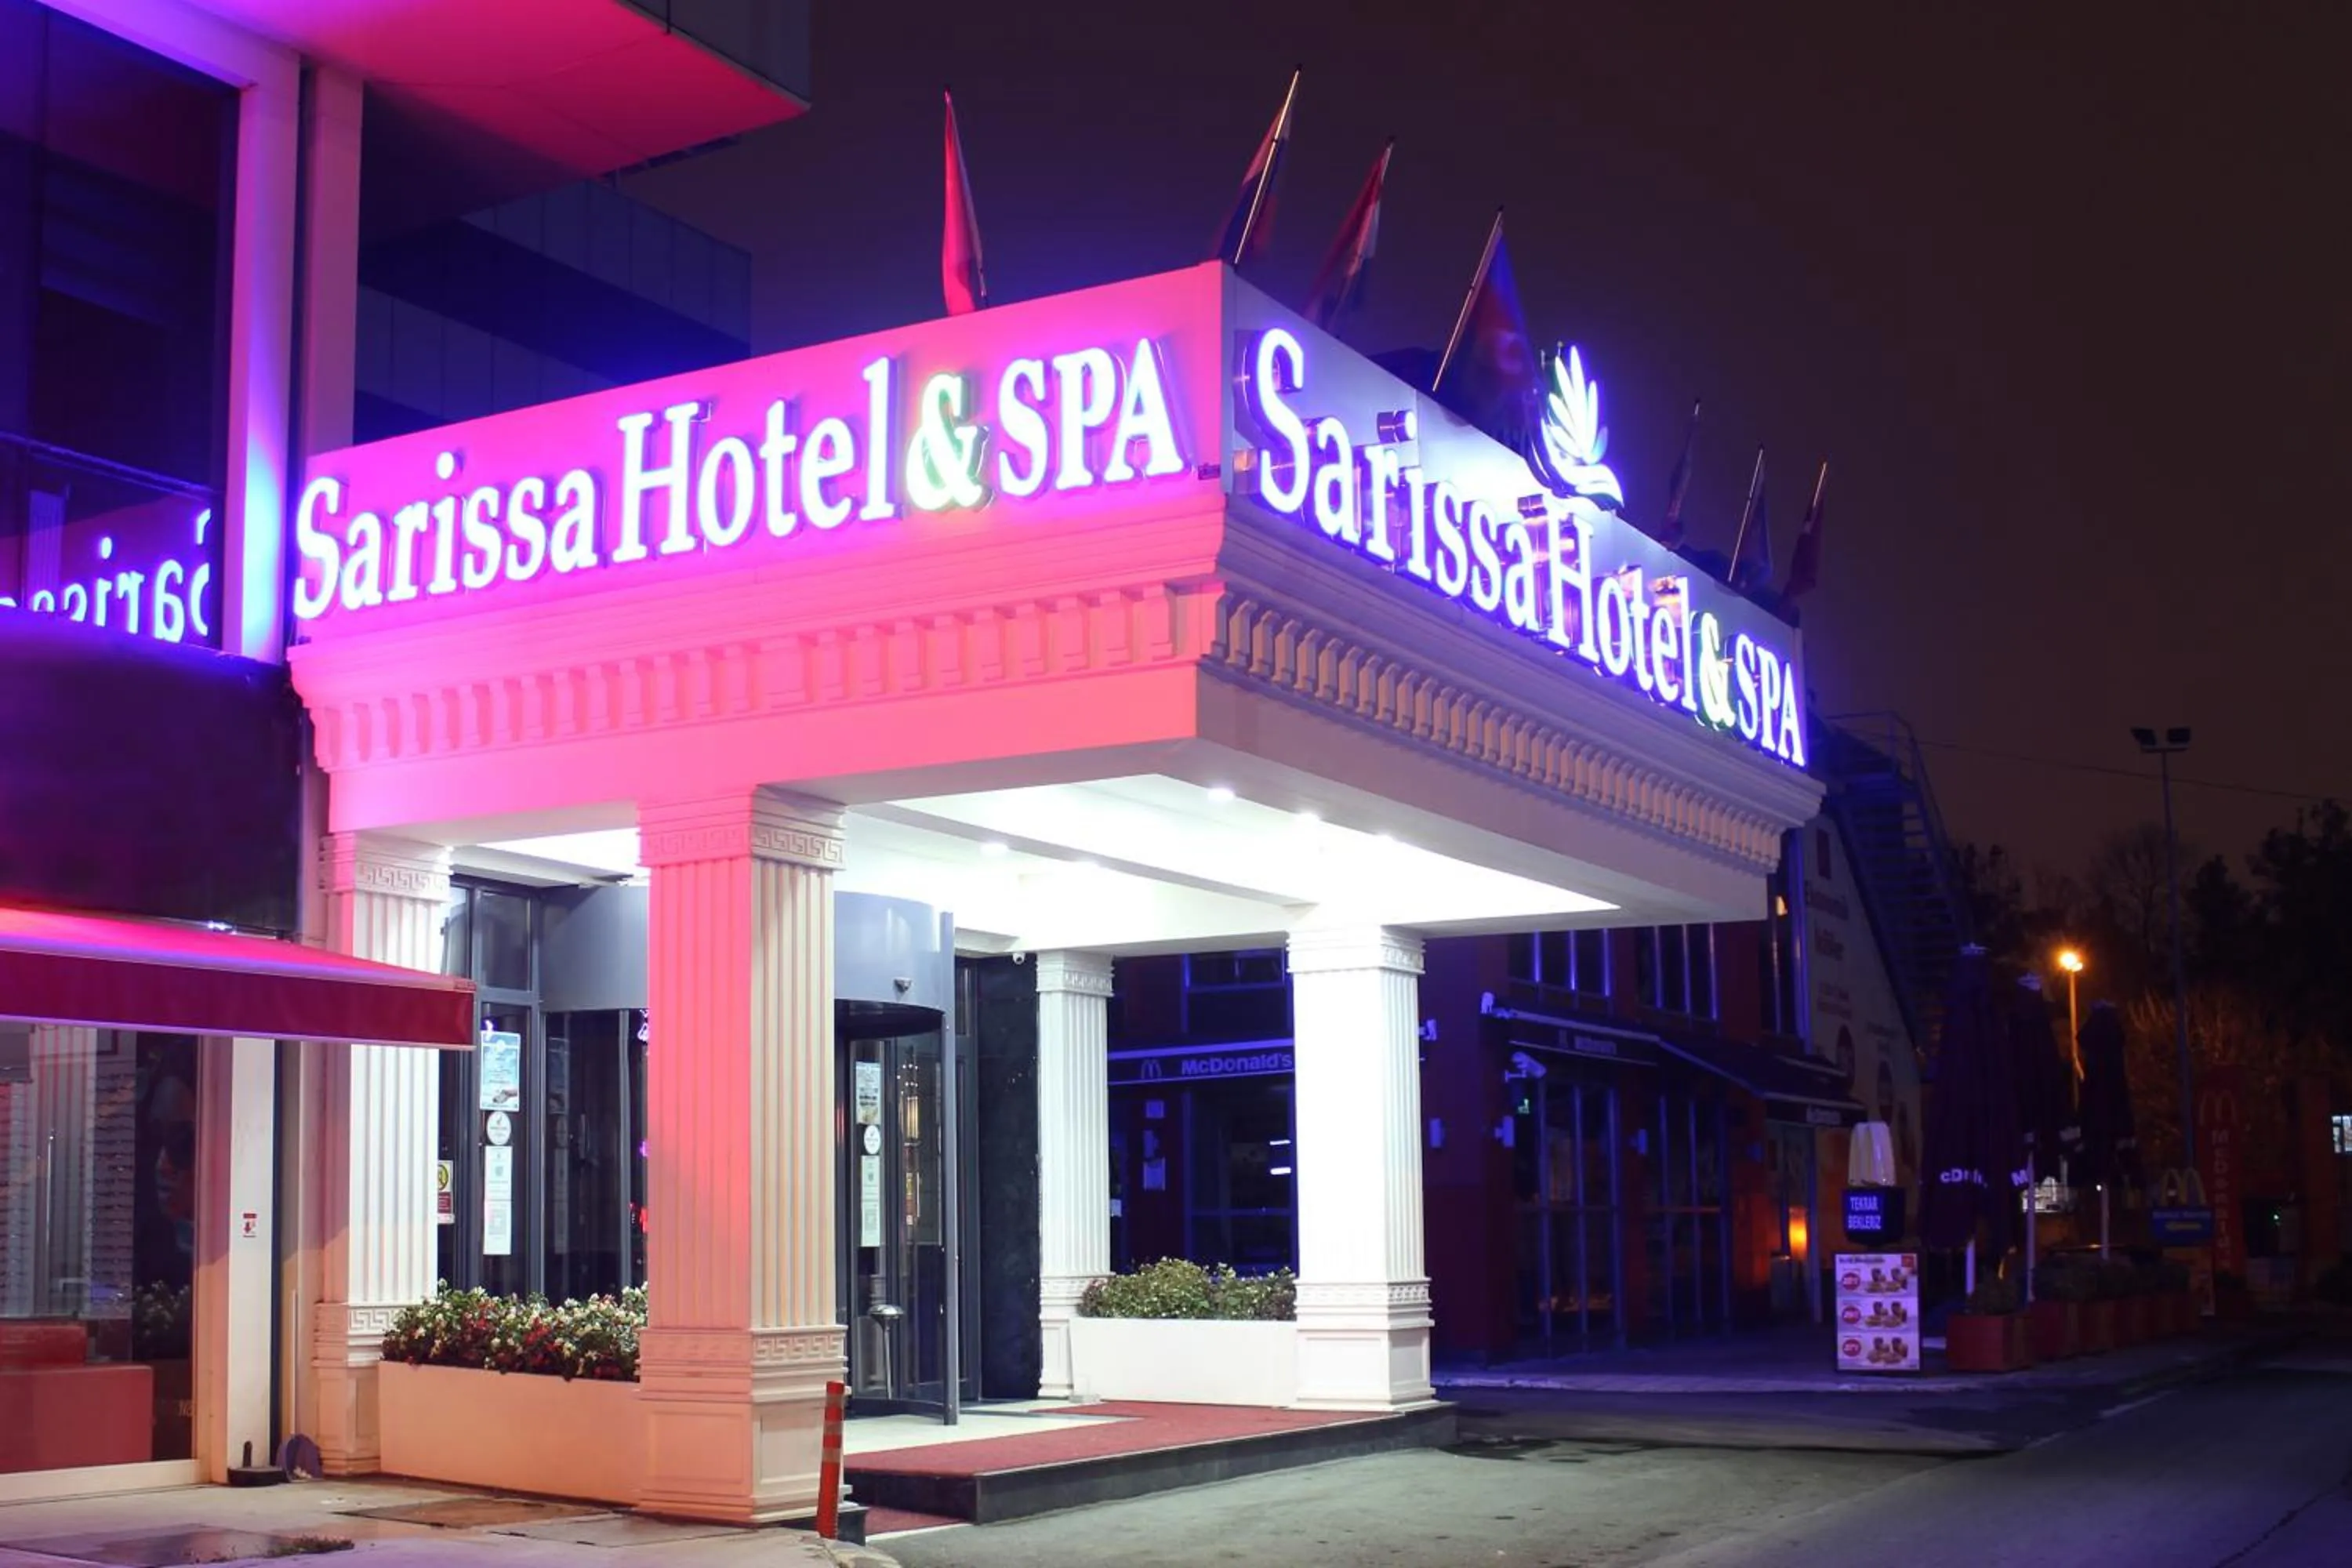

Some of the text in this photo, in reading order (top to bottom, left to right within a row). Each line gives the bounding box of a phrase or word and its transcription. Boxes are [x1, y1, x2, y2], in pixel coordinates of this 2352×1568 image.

[293, 336, 1185, 620] Sarissa Hotel & SPA
[1257, 327, 1806, 768] Sarissa Hotel & SPA
[1181, 1052, 1293, 1076] McDonald's
